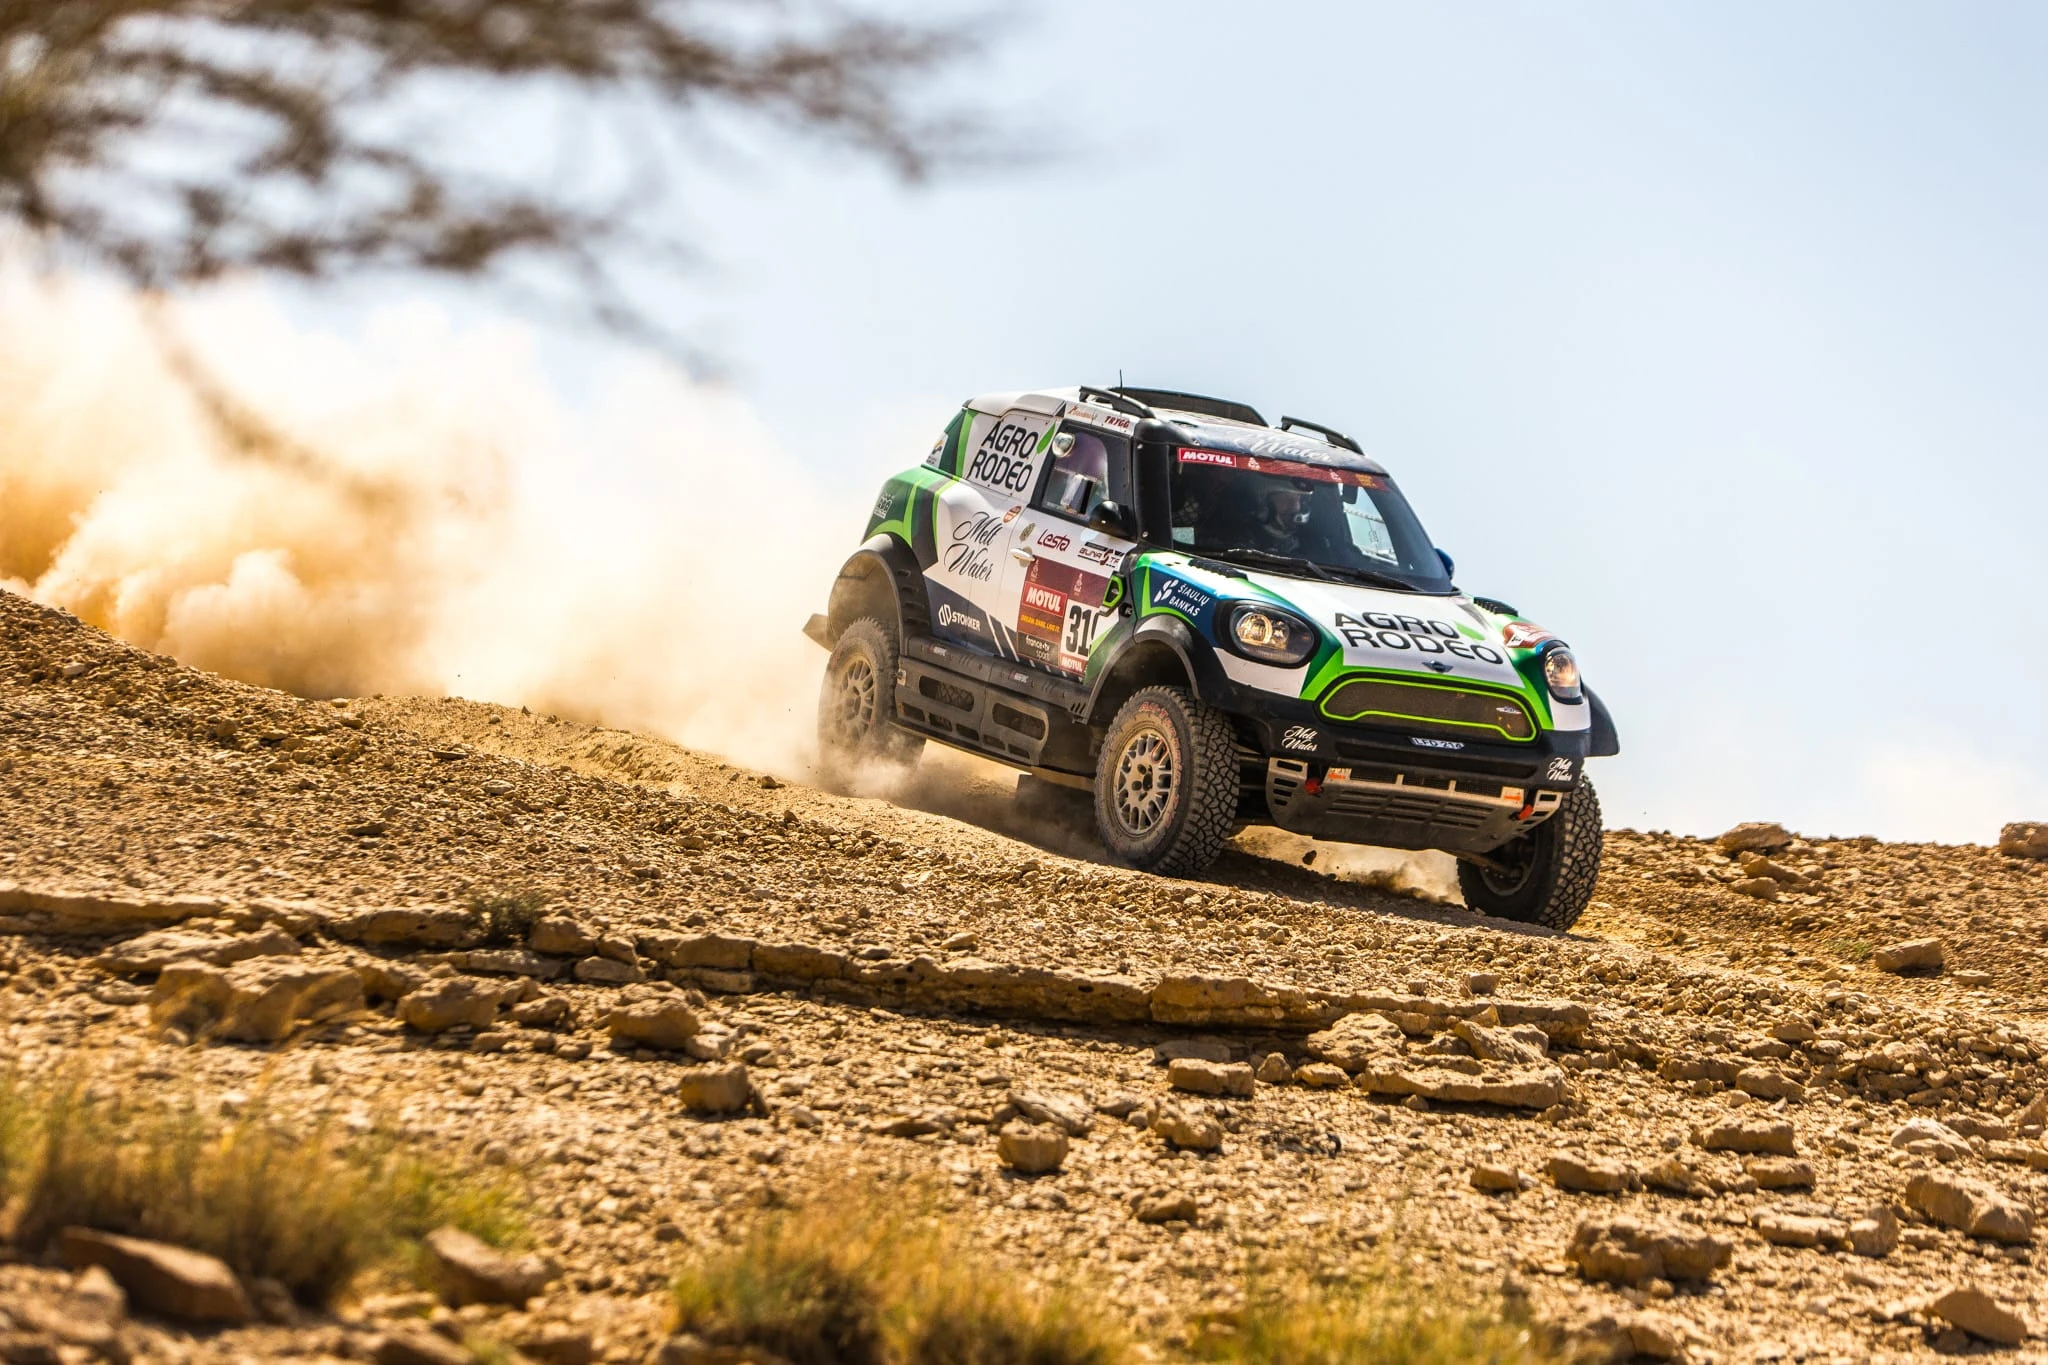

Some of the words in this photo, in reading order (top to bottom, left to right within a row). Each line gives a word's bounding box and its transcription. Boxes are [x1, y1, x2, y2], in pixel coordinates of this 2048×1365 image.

[1104, 415, 1130, 428] TRYGG
[981, 420, 1039, 459] AGRO
[966, 449, 1033, 492] RODEO
[1182, 451, 1233, 466] MOTUL
[953, 511, 1003, 546] Melt
[1037, 528, 1071, 552] Lesta
[943, 543, 994, 582] Water
[1026, 586, 1061, 613] MOTUL
[1169, 596, 1200, 616] BANKAS
[1178, 583, 1210, 607] ŠIAULIŲ
[1335, 612, 1460, 640] AGRO
[1341, 629, 1503, 664] RODEO
[1061, 655, 1083, 673] MOTUL
[1284, 725, 1318, 739] Melt
[1281, 737, 1318, 752] Water
